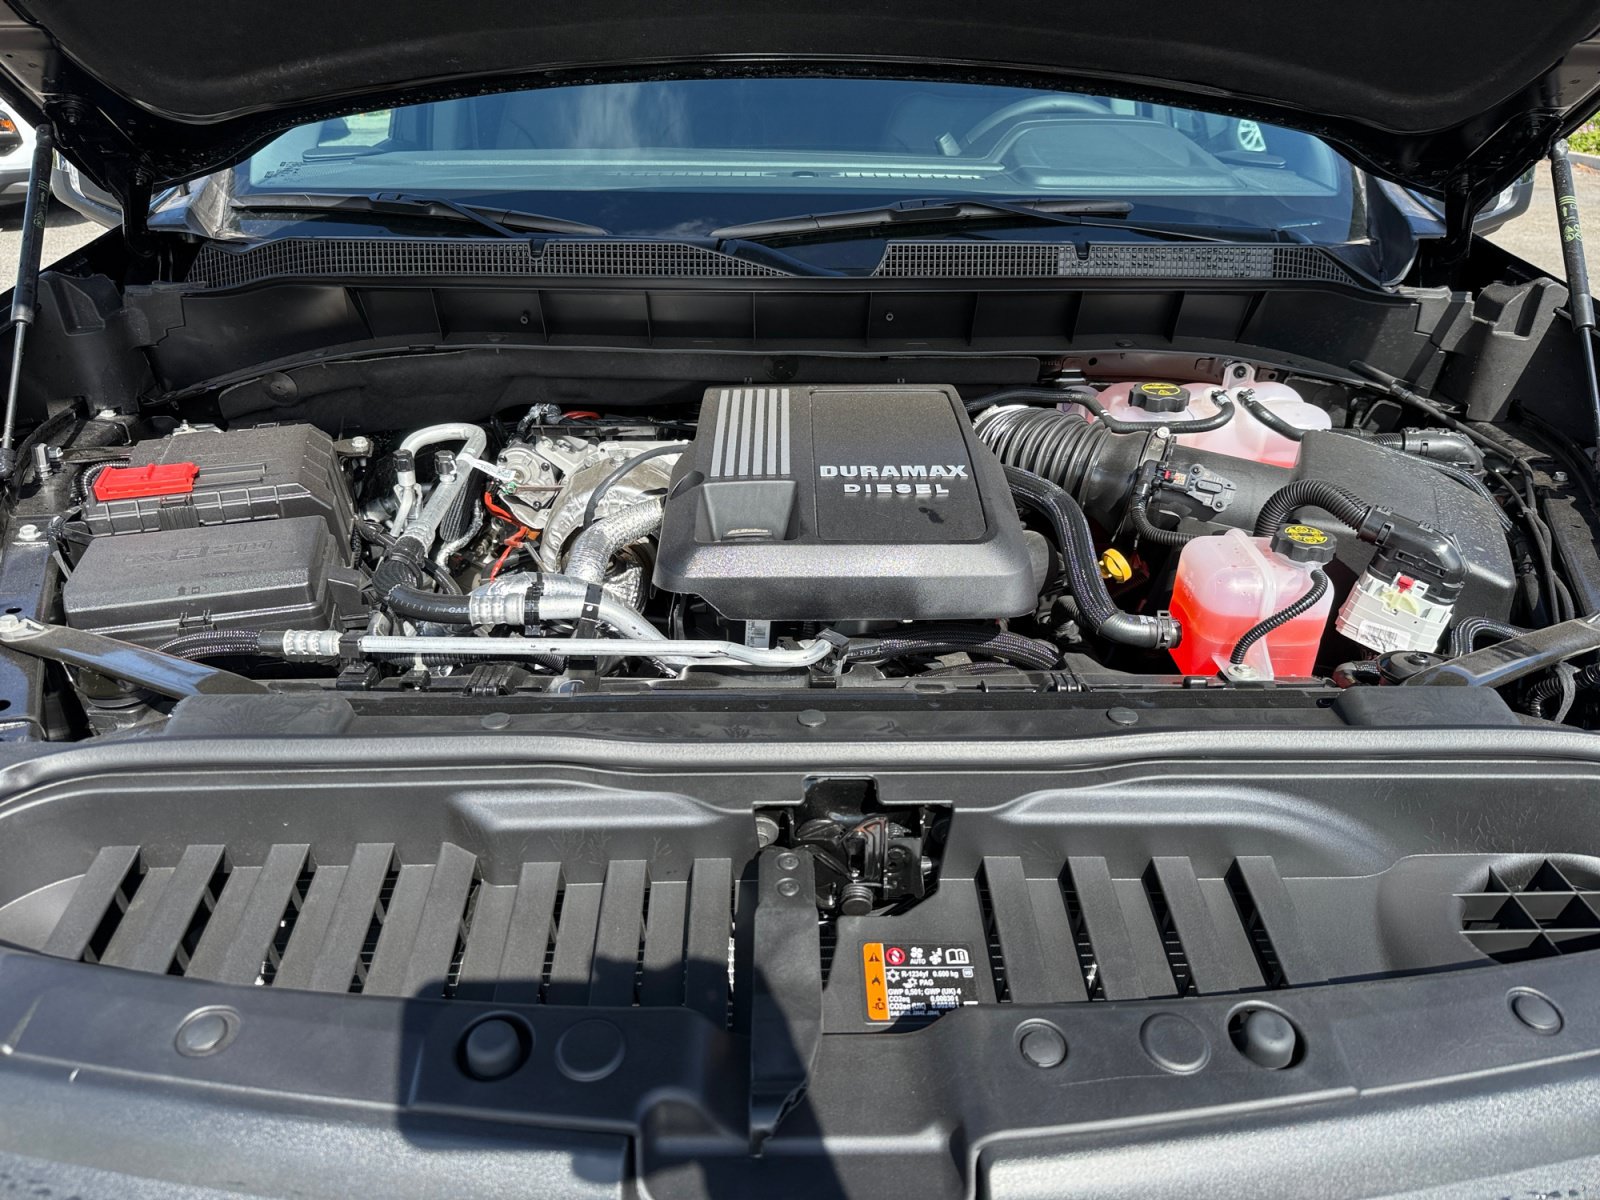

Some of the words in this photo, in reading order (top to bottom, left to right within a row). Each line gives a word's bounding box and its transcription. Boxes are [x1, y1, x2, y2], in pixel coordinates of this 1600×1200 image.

[820, 464, 968, 478] DURAMAX
[843, 483, 950, 496] DIESEL
[448, 606, 470, 614] GAT
[950, 970, 959, 978] kg
[919, 978, 934, 986] PAG
